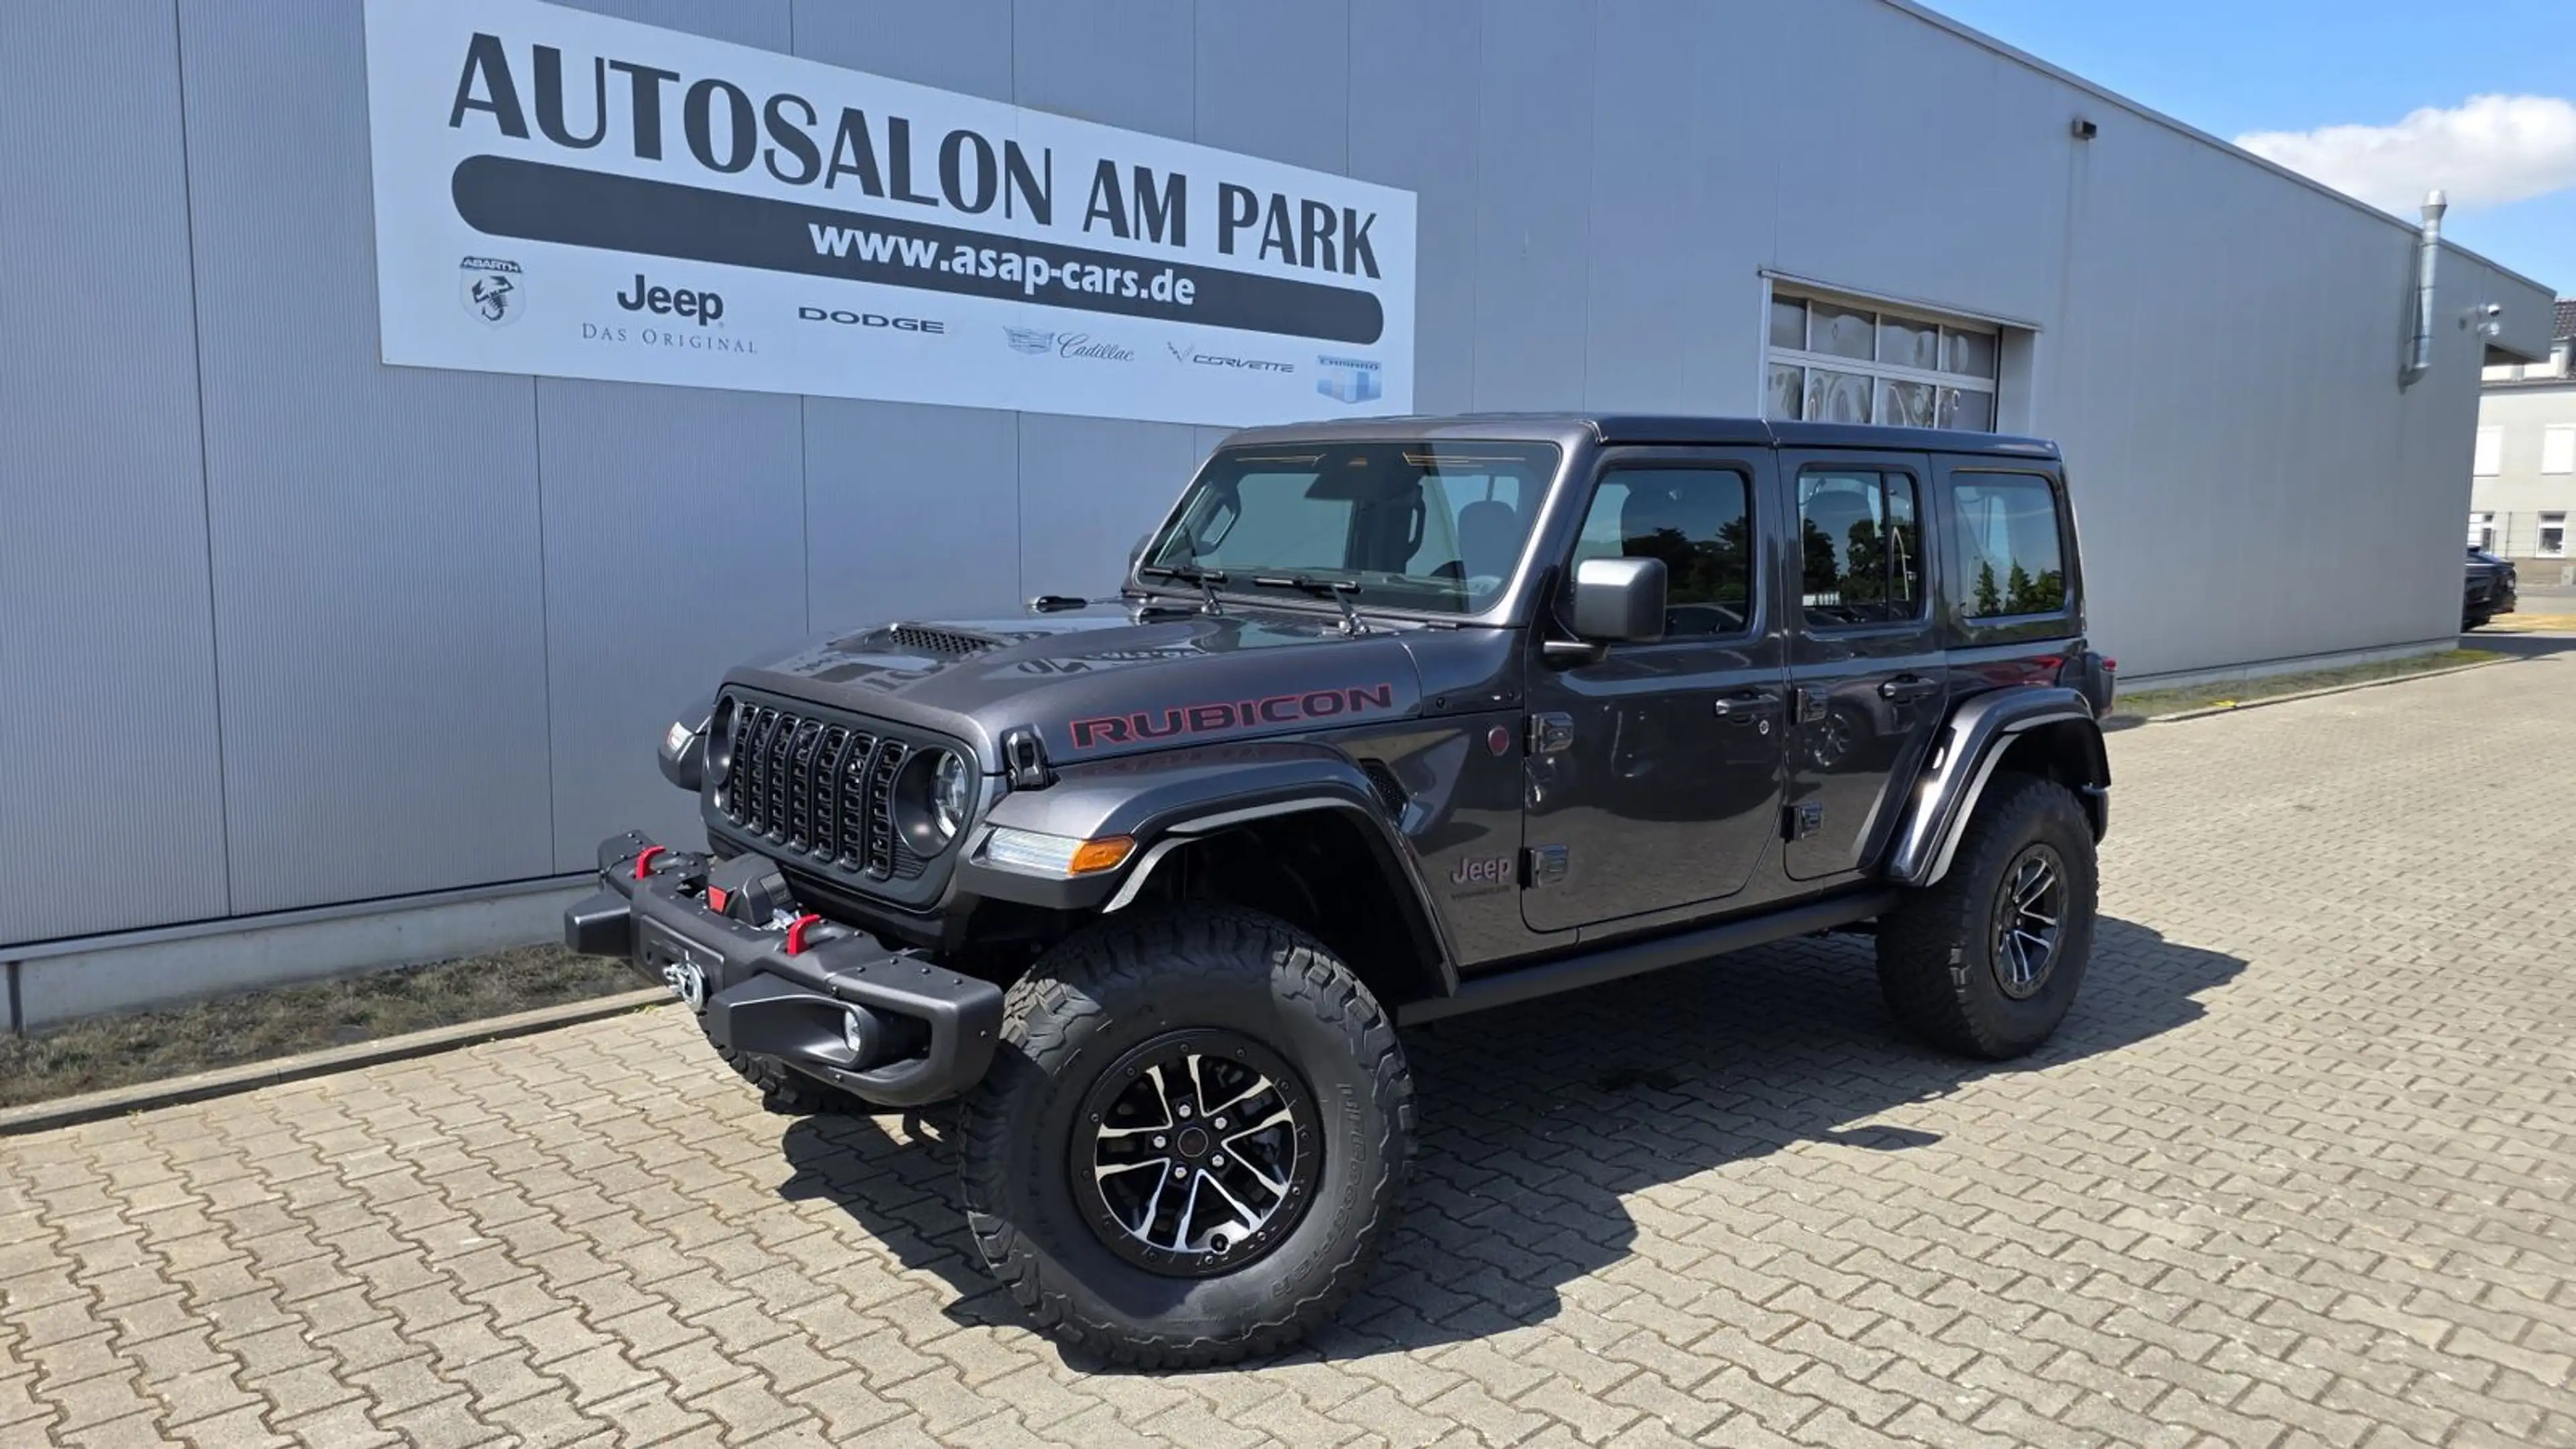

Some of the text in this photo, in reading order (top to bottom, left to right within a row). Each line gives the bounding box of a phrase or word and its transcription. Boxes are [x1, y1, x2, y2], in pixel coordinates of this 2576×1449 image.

[449, 32, 1381, 280] AUTOSALON AM PARK
[808, 222, 1195, 305] www.asap-cars.de
[616, 274, 724, 326] Jeep
[798, 307, 945, 334] DODGE
[582, 323, 755, 354] DAS ORIGINAL
[1057, 333, 1136, 362] Cadillac
[1069, 683, 1392, 750] RUBICON
[1450, 856, 1512, 884] Jeep
